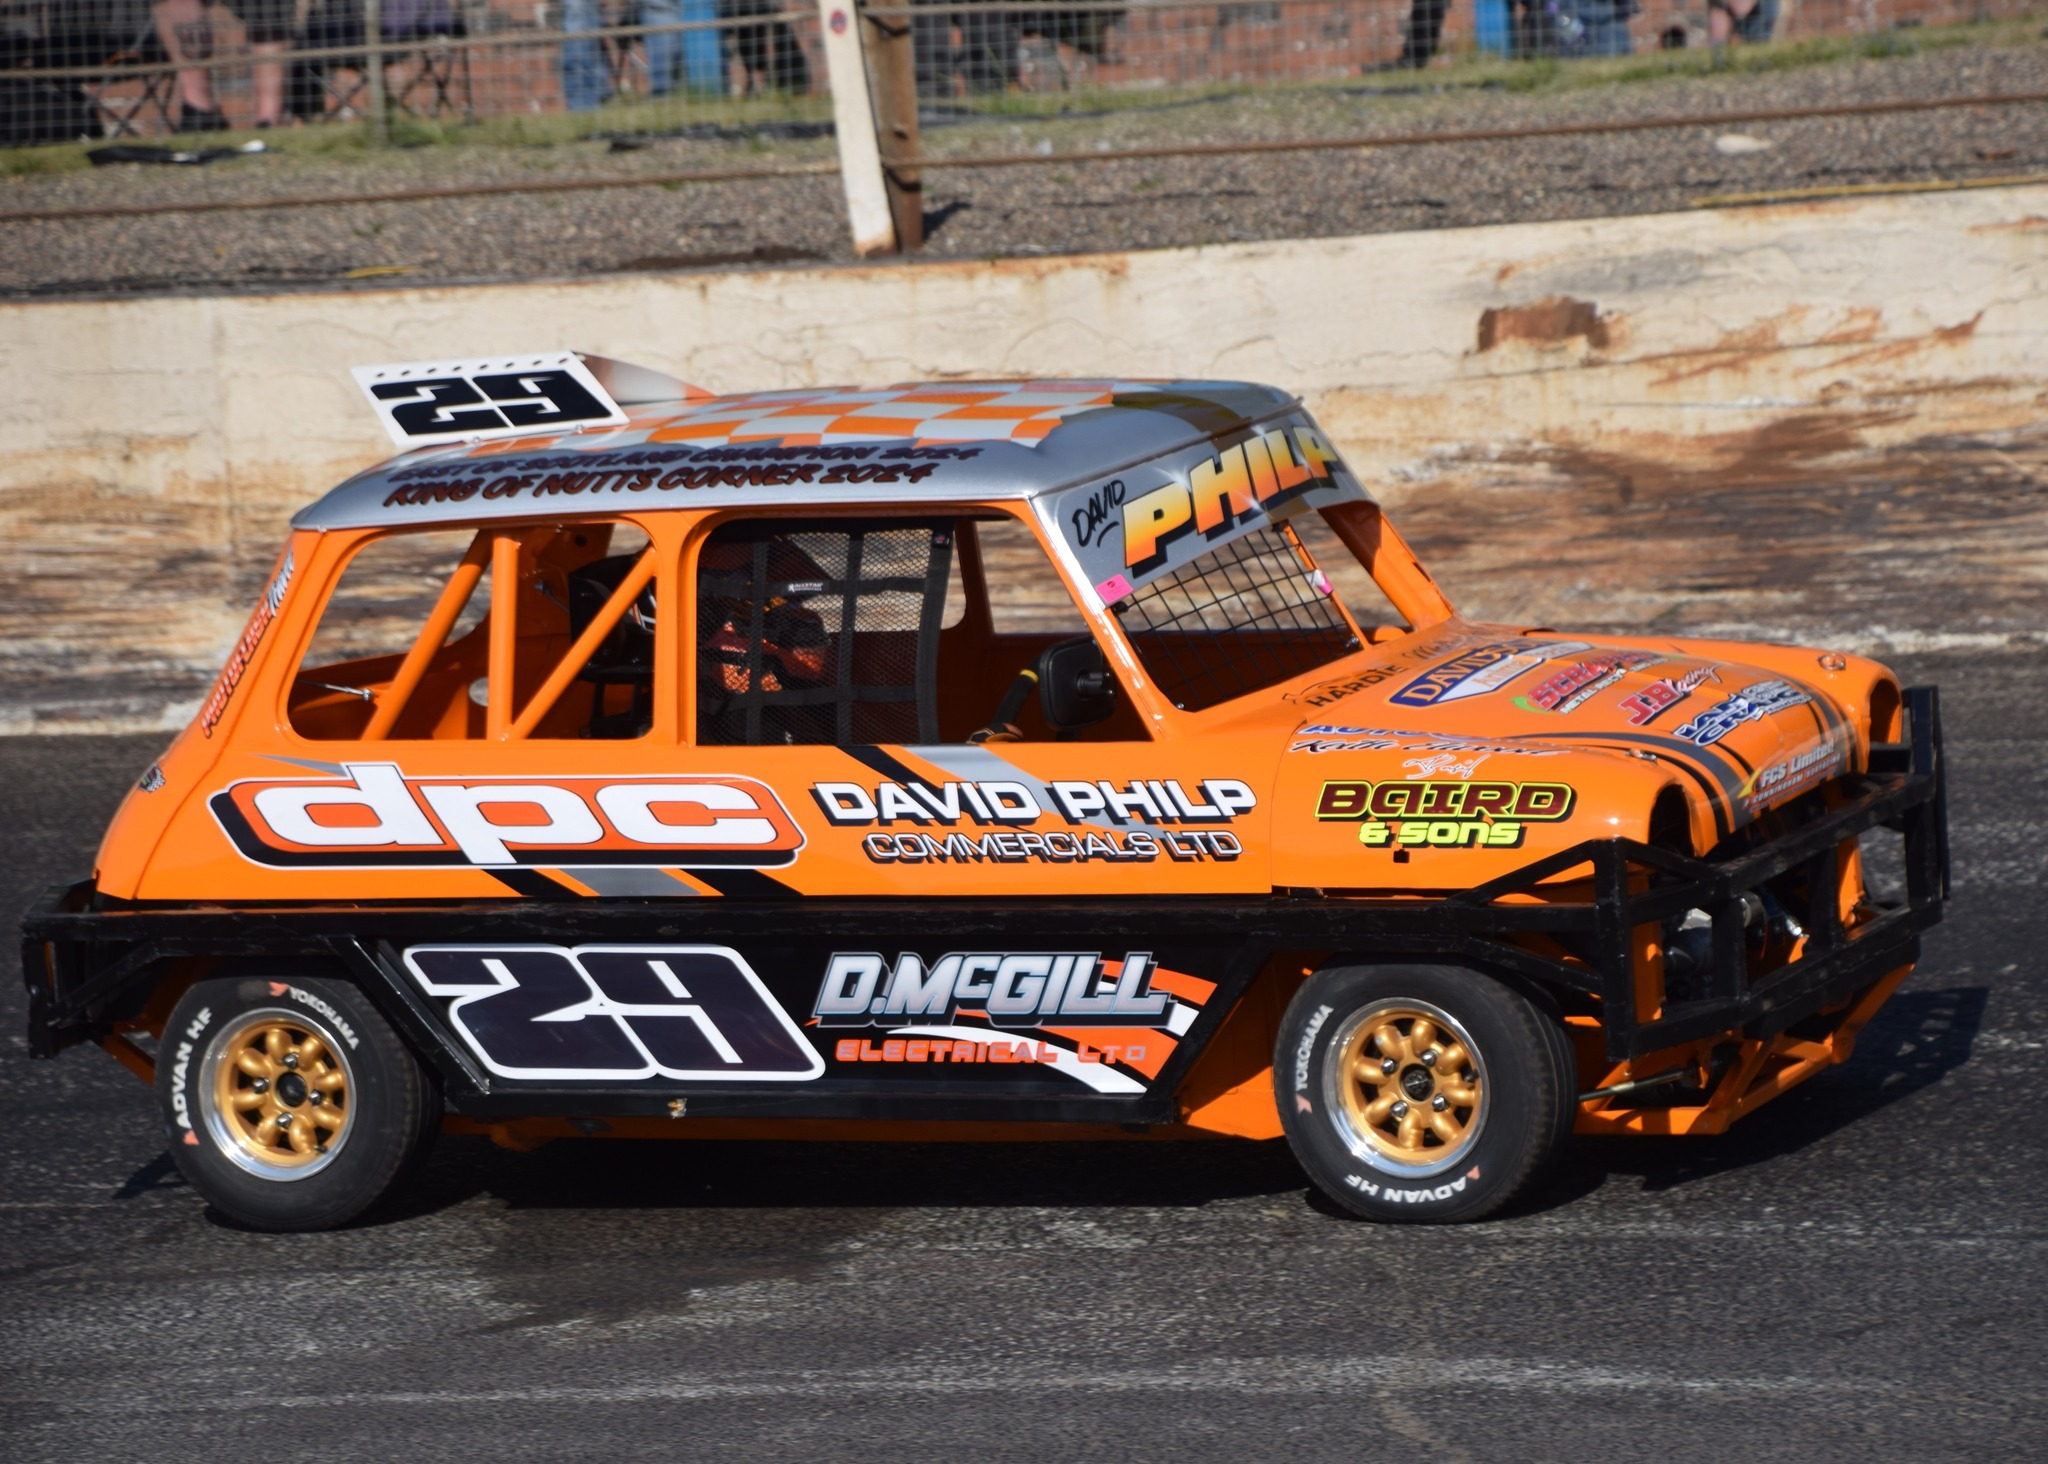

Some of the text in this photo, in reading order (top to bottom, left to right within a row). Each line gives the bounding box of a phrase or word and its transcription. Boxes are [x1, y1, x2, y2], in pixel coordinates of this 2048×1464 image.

[370, 370, 613, 436] 29
[471, 458, 517, 475] OF
[516, 449, 693, 471] SCOTLAND
[689, 446, 881, 463] CHAMPION
[383, 462, 941, 508] KING OF NUTTS CORNER 2024
[1122, 425, 1338, 574] PHILP
[1071, 479, 1126, 547] DAVID
[1305, 664, 1408, 707] HARDIE
[1558, 687, 1599, 715] METAL
[1752, 773, 1804, 804] CUNNINGHAM
[1760, 761, 1789, 788] FCS
[252, 763, 778, 865] dpc
[811, 779, 1258, 823] DAVID PHILP
[1313, 780, 1576, 821] BAIRD
[864, 829, 1244, 862] COMMERCIALS LTD
[1358, 821, 1391, 846] &
[287, 984, 361, 1051] YOKOHAMA
[402, 943, 827, 1082] 29
[171, 1006, 213, 1130] ADVAN HF
[835, 1038, 1146, 1065] ELECTRICAL LTD
[1295, 1003, 1335, 1092] YOKOHAMA
[1343, 1173, 1468, 1204] ADVAN HF
